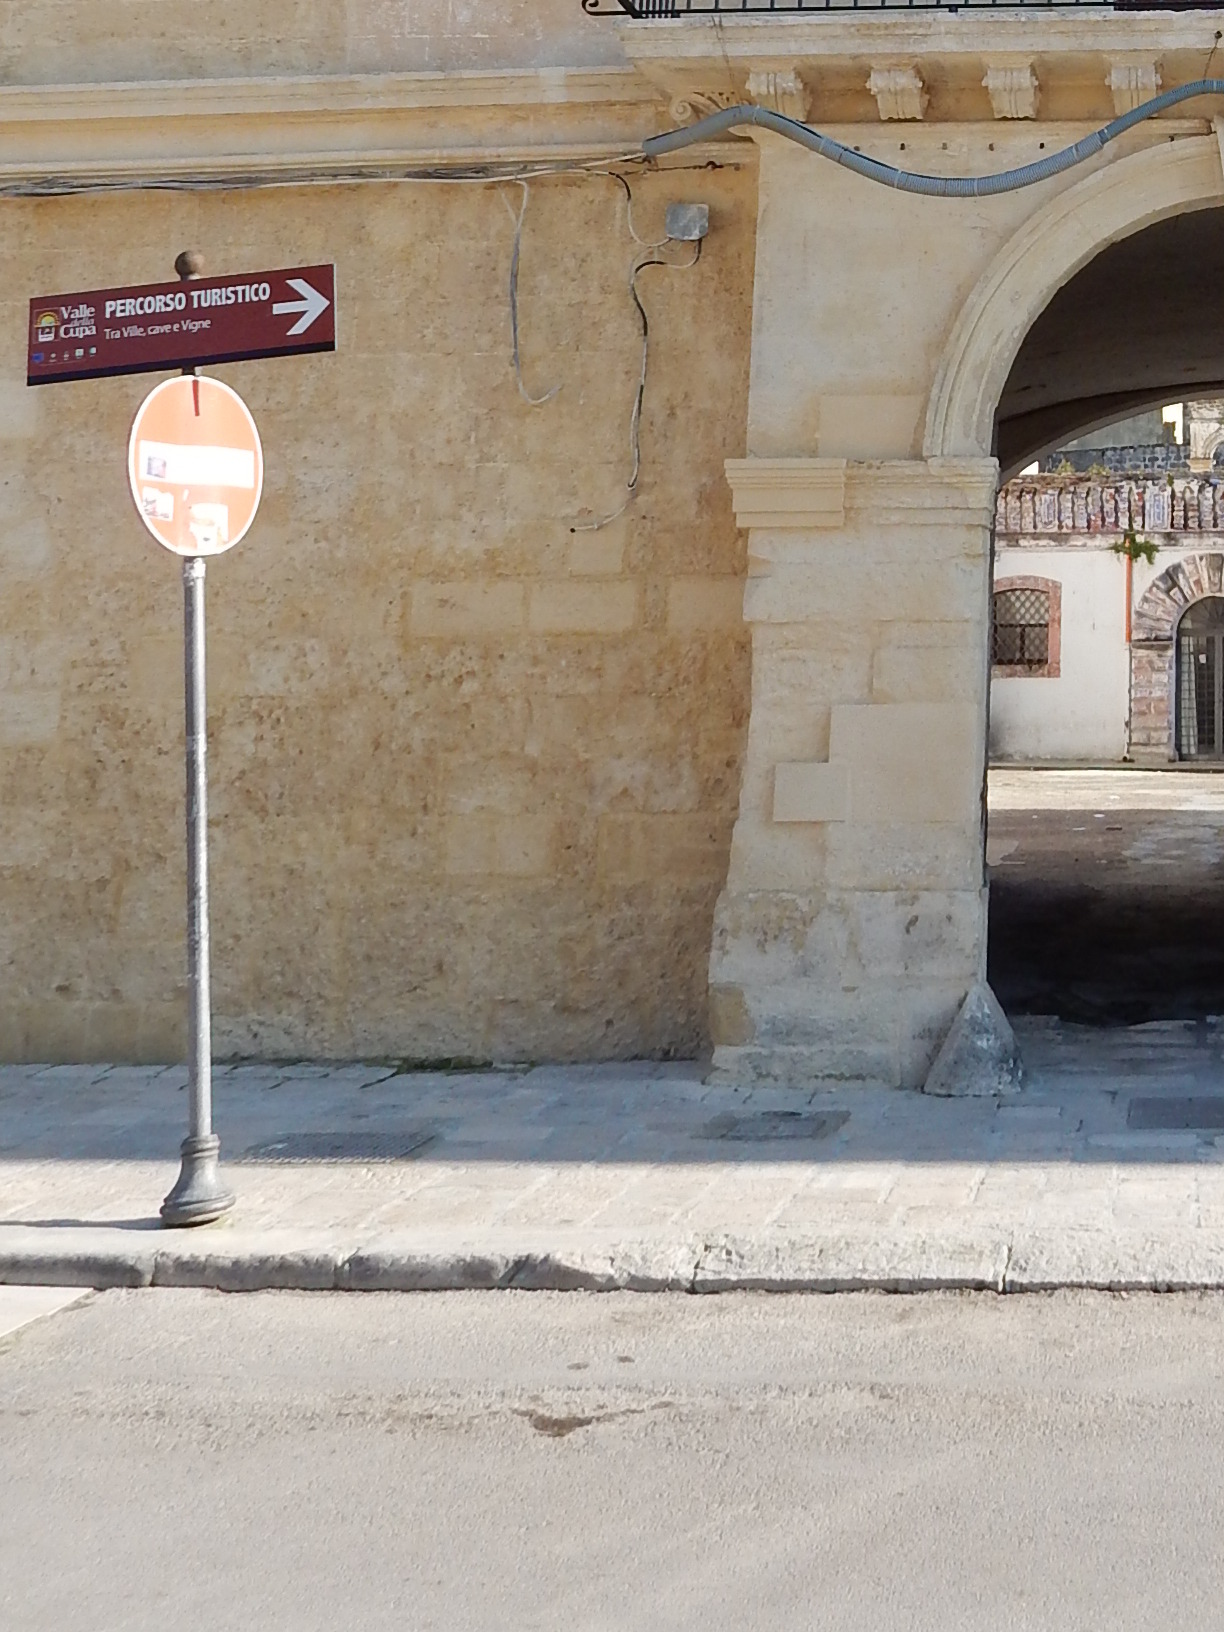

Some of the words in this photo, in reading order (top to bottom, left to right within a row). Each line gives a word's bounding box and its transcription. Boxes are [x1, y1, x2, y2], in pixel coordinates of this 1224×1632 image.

[105, 293, 186, 318] PERCORSO
[190, 283, 270, 308] TURISTICO
[60, 304, 96, 319] Valle
[60, 324, 97, 339] Cupa
[104, 328, 121, 339] Tra
[122, 325, 146, 337] Ville,
[147, 324, 171, 335] cave
[173, 324, 179, 332] e
[181, 319, 211, 333] Vigne
